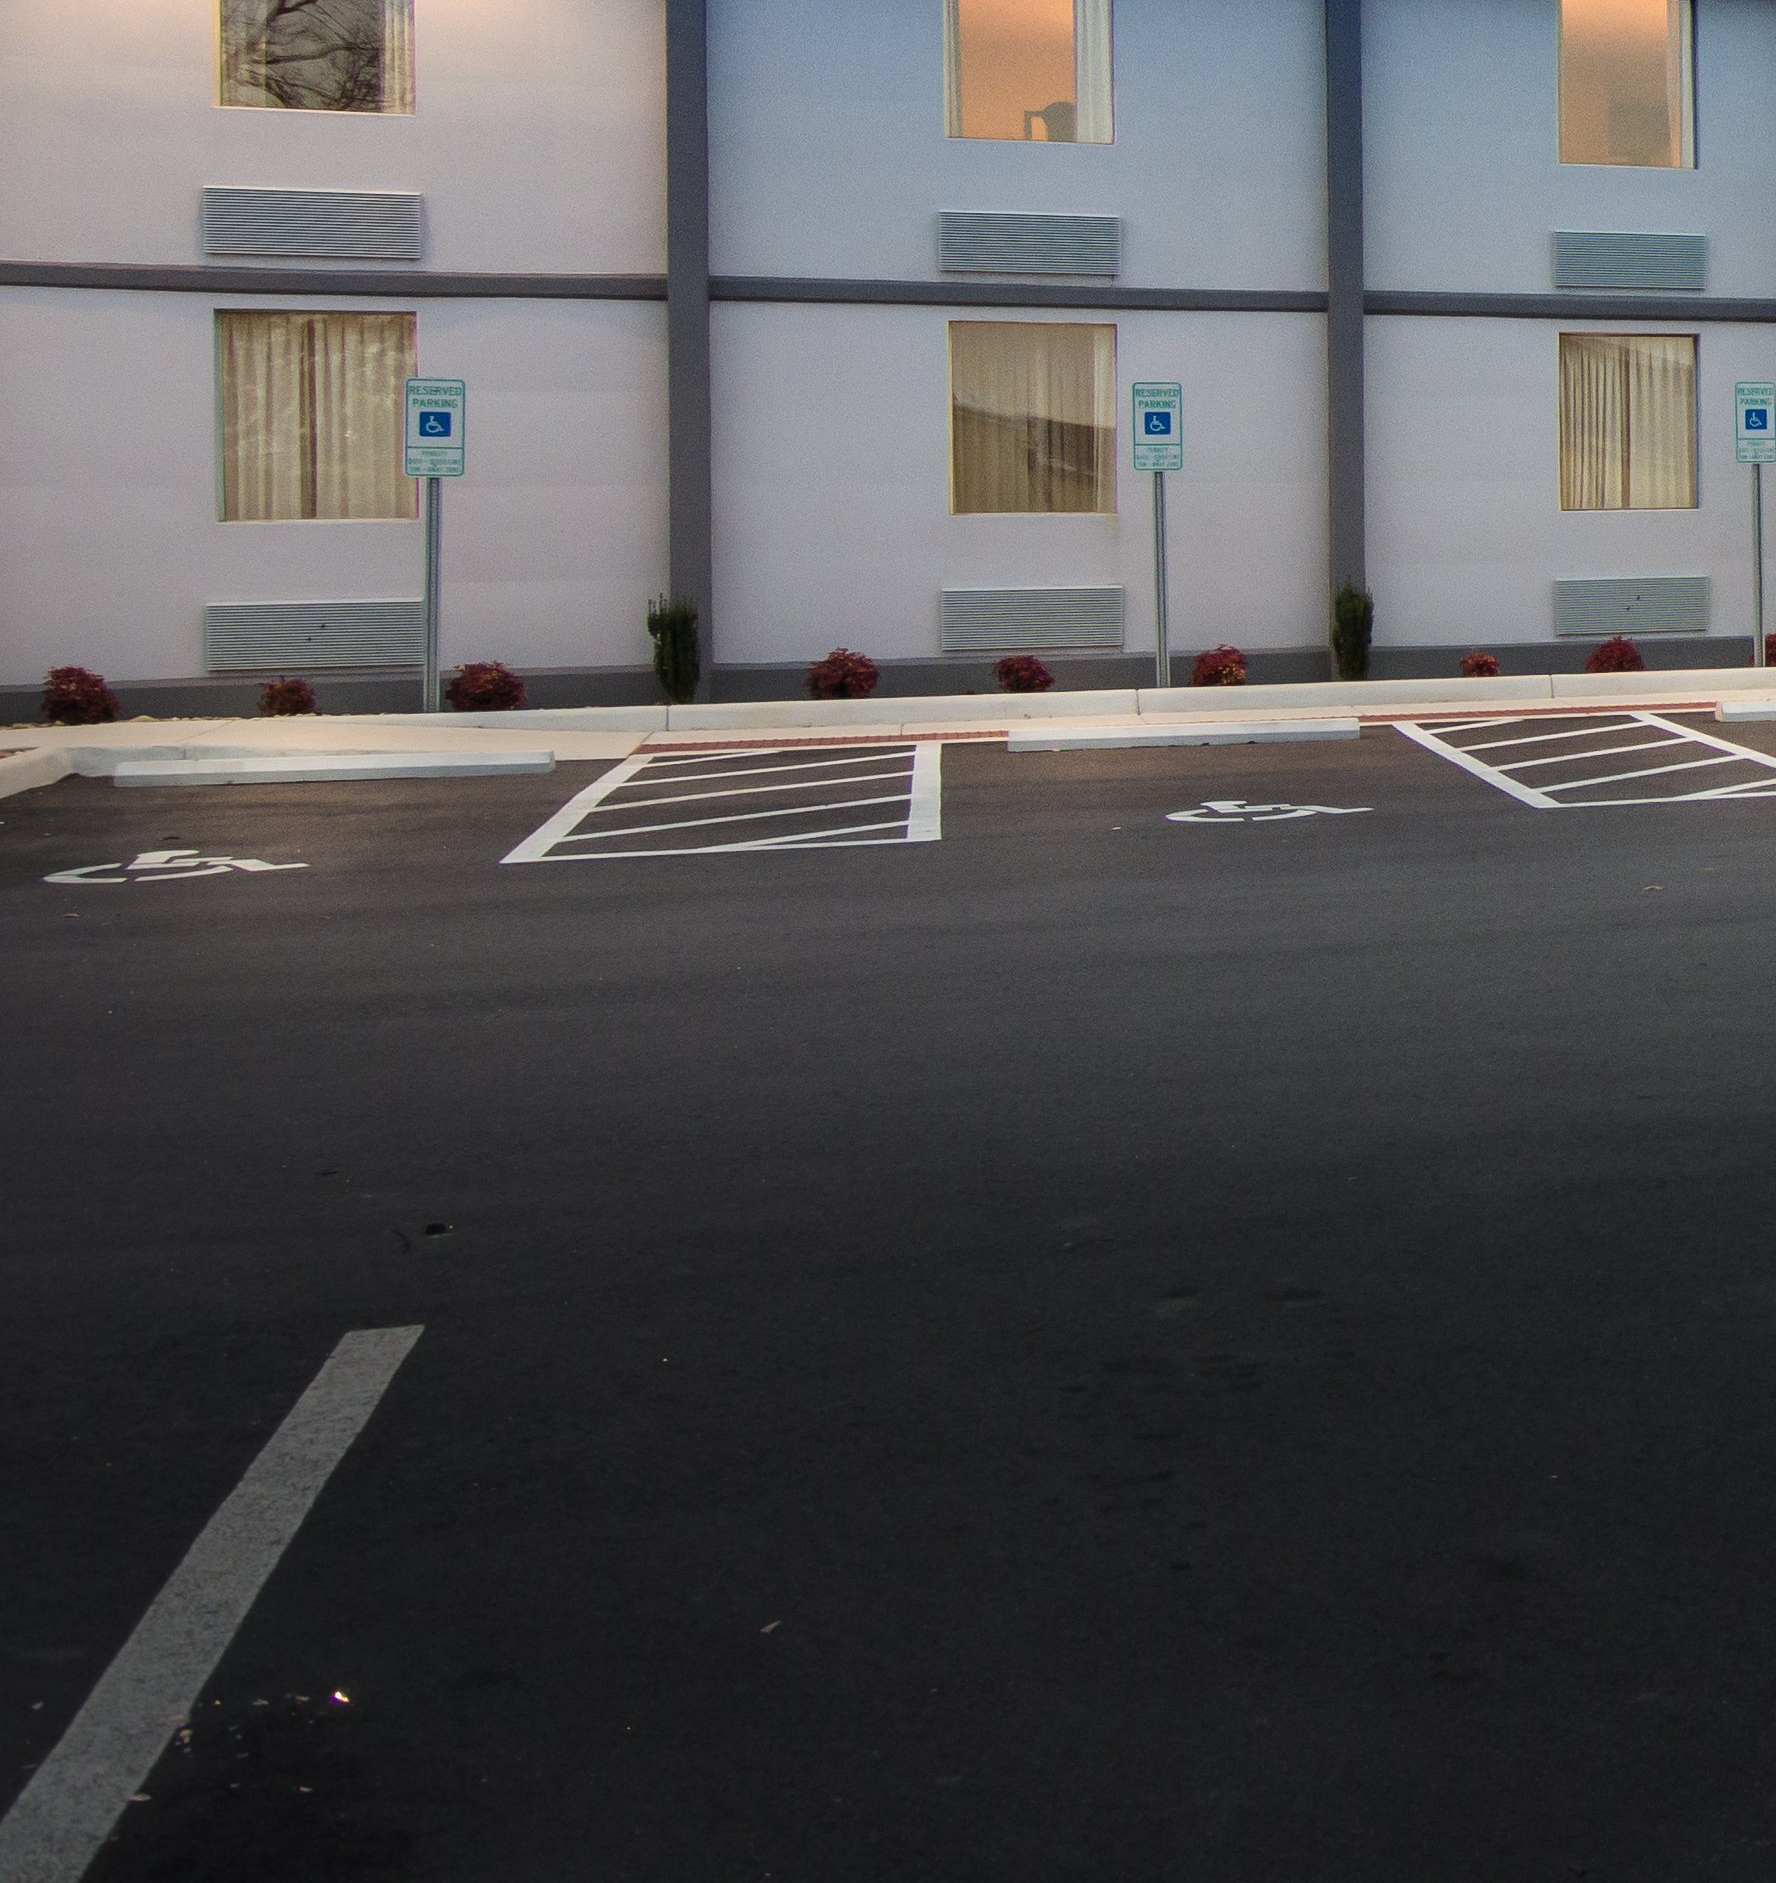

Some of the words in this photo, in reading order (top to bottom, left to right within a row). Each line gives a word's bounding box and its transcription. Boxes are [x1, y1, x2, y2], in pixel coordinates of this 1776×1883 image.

[408, 385, 462, 396] RESERVED
[1135, 388, 1179, 397] RESERVED
[1738, 387, 1775, 396] RESERVED
[412, 398, 458, 408] PARKING
[1138, 400, 1176, 409] PARKING
[1740, 397, 1772, 406] PARKING
